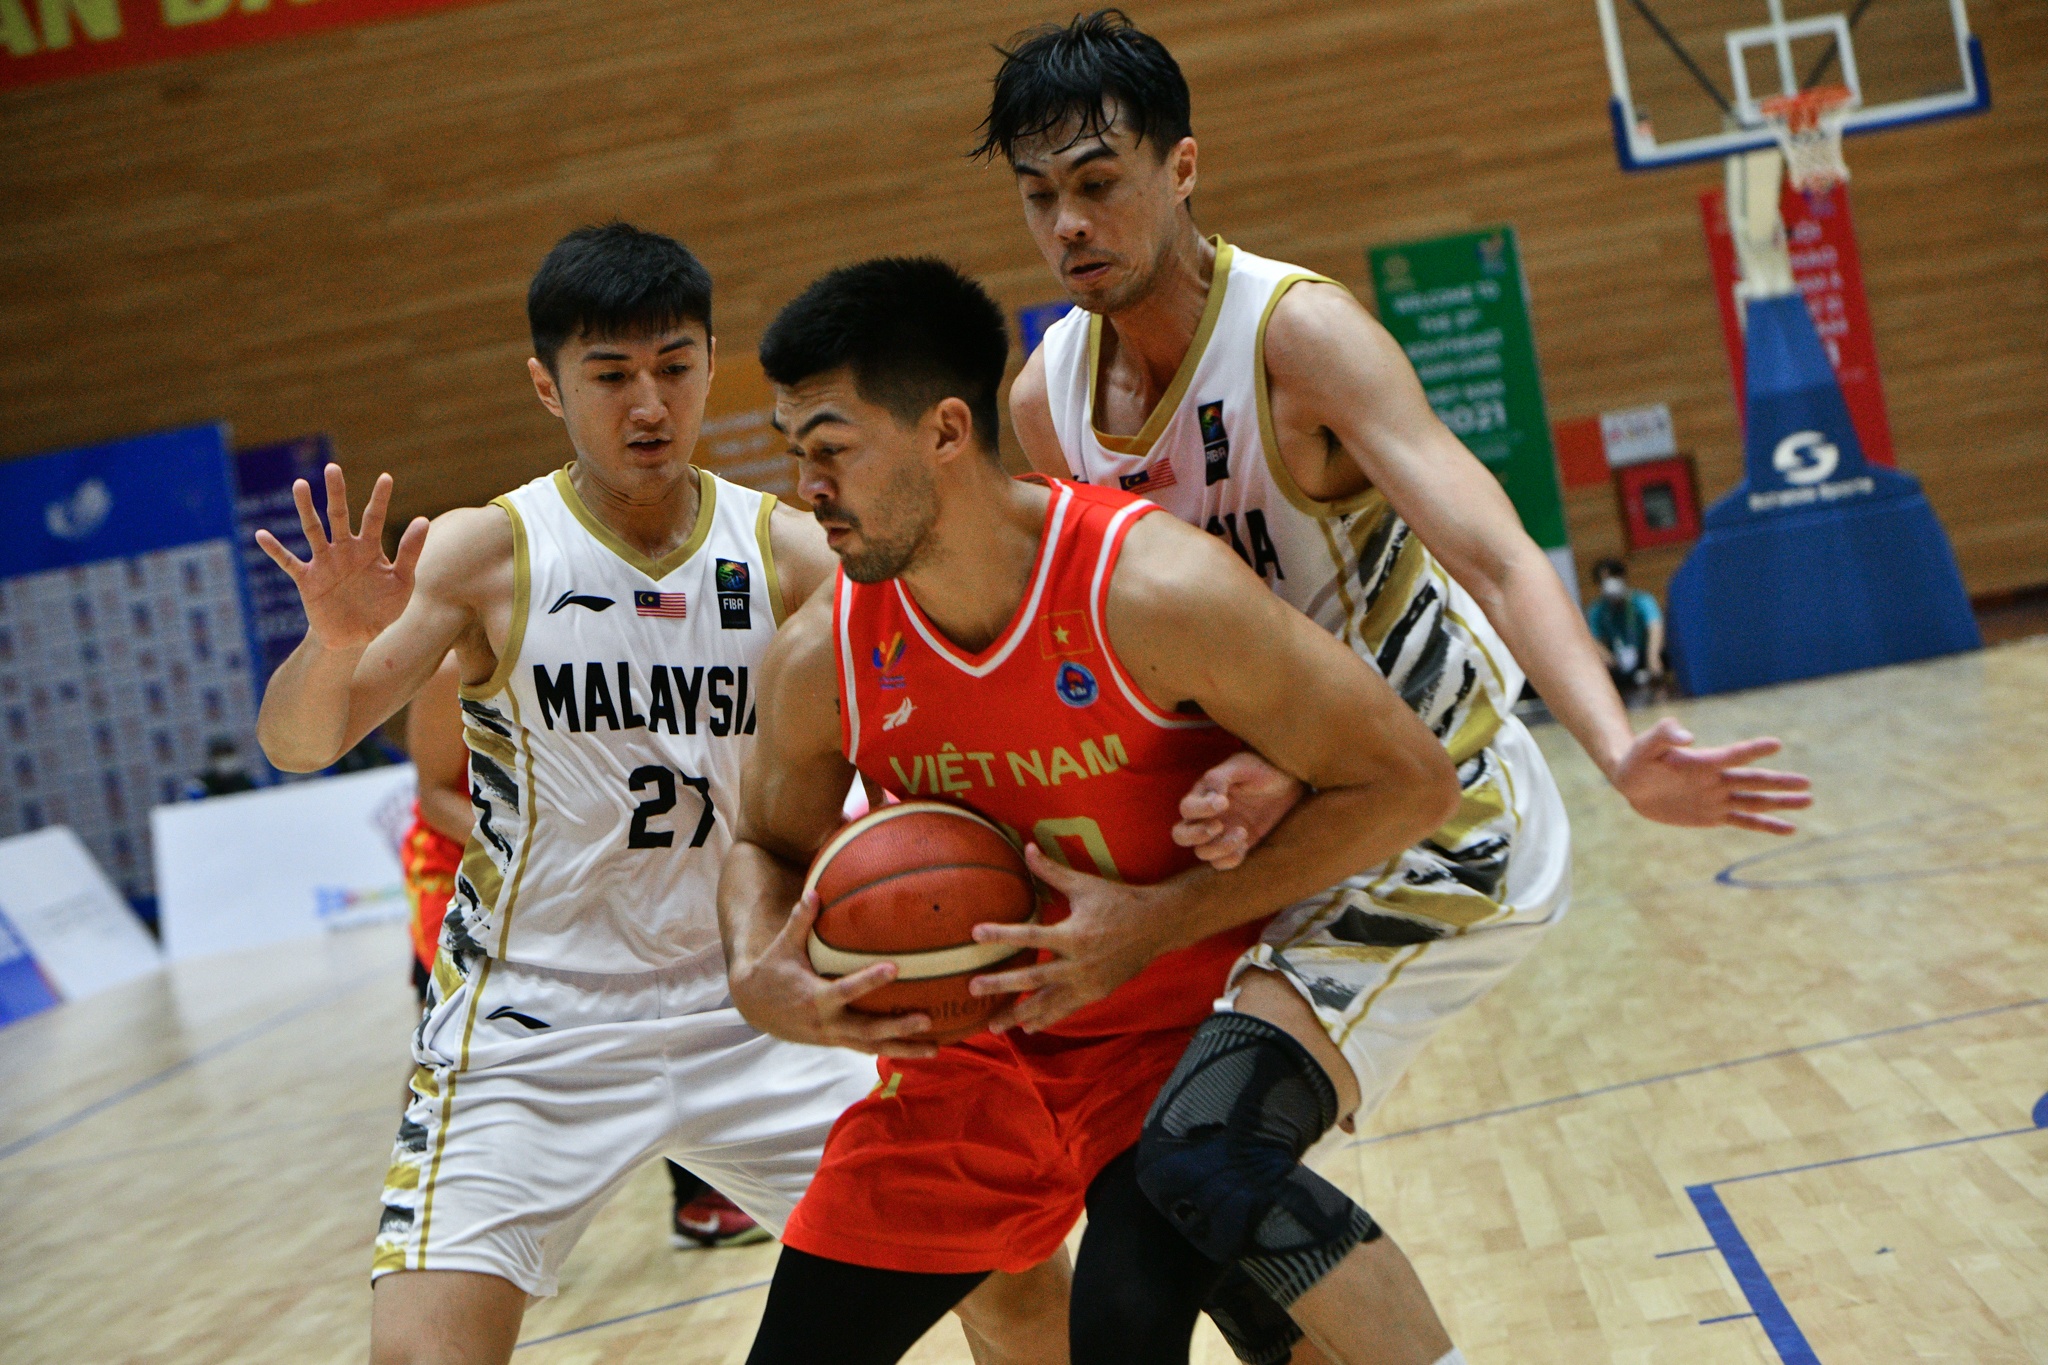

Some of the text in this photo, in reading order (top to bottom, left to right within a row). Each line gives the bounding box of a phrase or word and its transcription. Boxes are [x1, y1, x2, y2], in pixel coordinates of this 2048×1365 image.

[722, 597, 745, 611] FIBA
[532, 661, 757, 737] MALAYSI
[889, 734, 1129, 800] VIỆT NAM
[627, 765, 716, 849] 27
